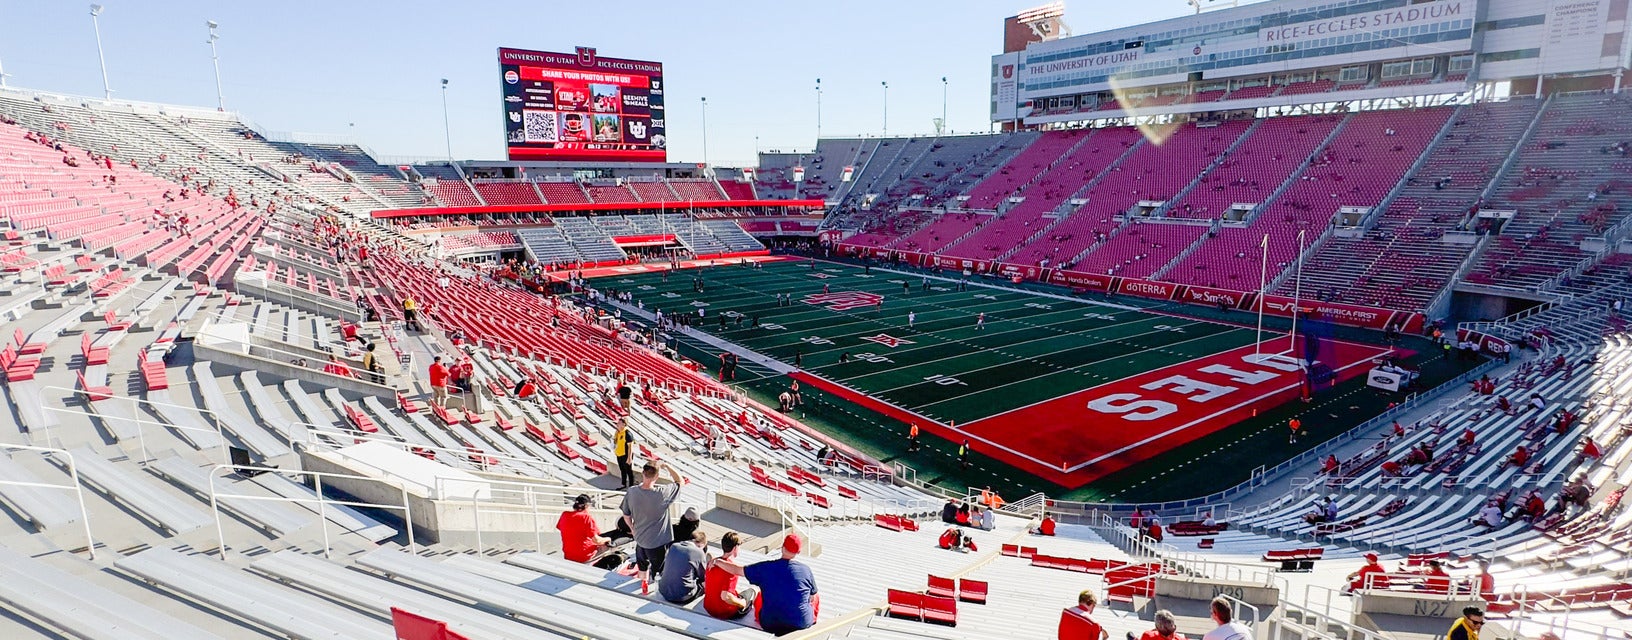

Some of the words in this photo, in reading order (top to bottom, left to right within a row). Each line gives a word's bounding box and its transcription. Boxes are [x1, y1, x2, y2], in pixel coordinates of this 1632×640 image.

[1556, 7, 1597, 16] CHAMPIONS
[1267, 16, 1367, 41] RICE-ECCLES
[1373, 3, 1460, 26] STADIUM
[504, 52, 544, 62] UNIVERSITY
[556, 57, 575, 65] UTAH
[1030, 65, 1044, 75] THE
[1047, 58, 1094, 72] UNIVERSITY
[1096, 56, 1109, 65] OF
[1111, 52, 1138, 63] UTAH
[597, 61, 634, 70] RICE-ECCLES
[542, 70, 563, 78] SHARE
[580, 73, 604, 81] PHOTOS
[1068, 276, 1083, 284] Honda
[1083, 278, 1102, 286] Dealers
[1316, 306, 1352, 317] AMERICA
[1353, 310, 1378, 320] FIRST
[1087, 353, 1321, 421] UTES
